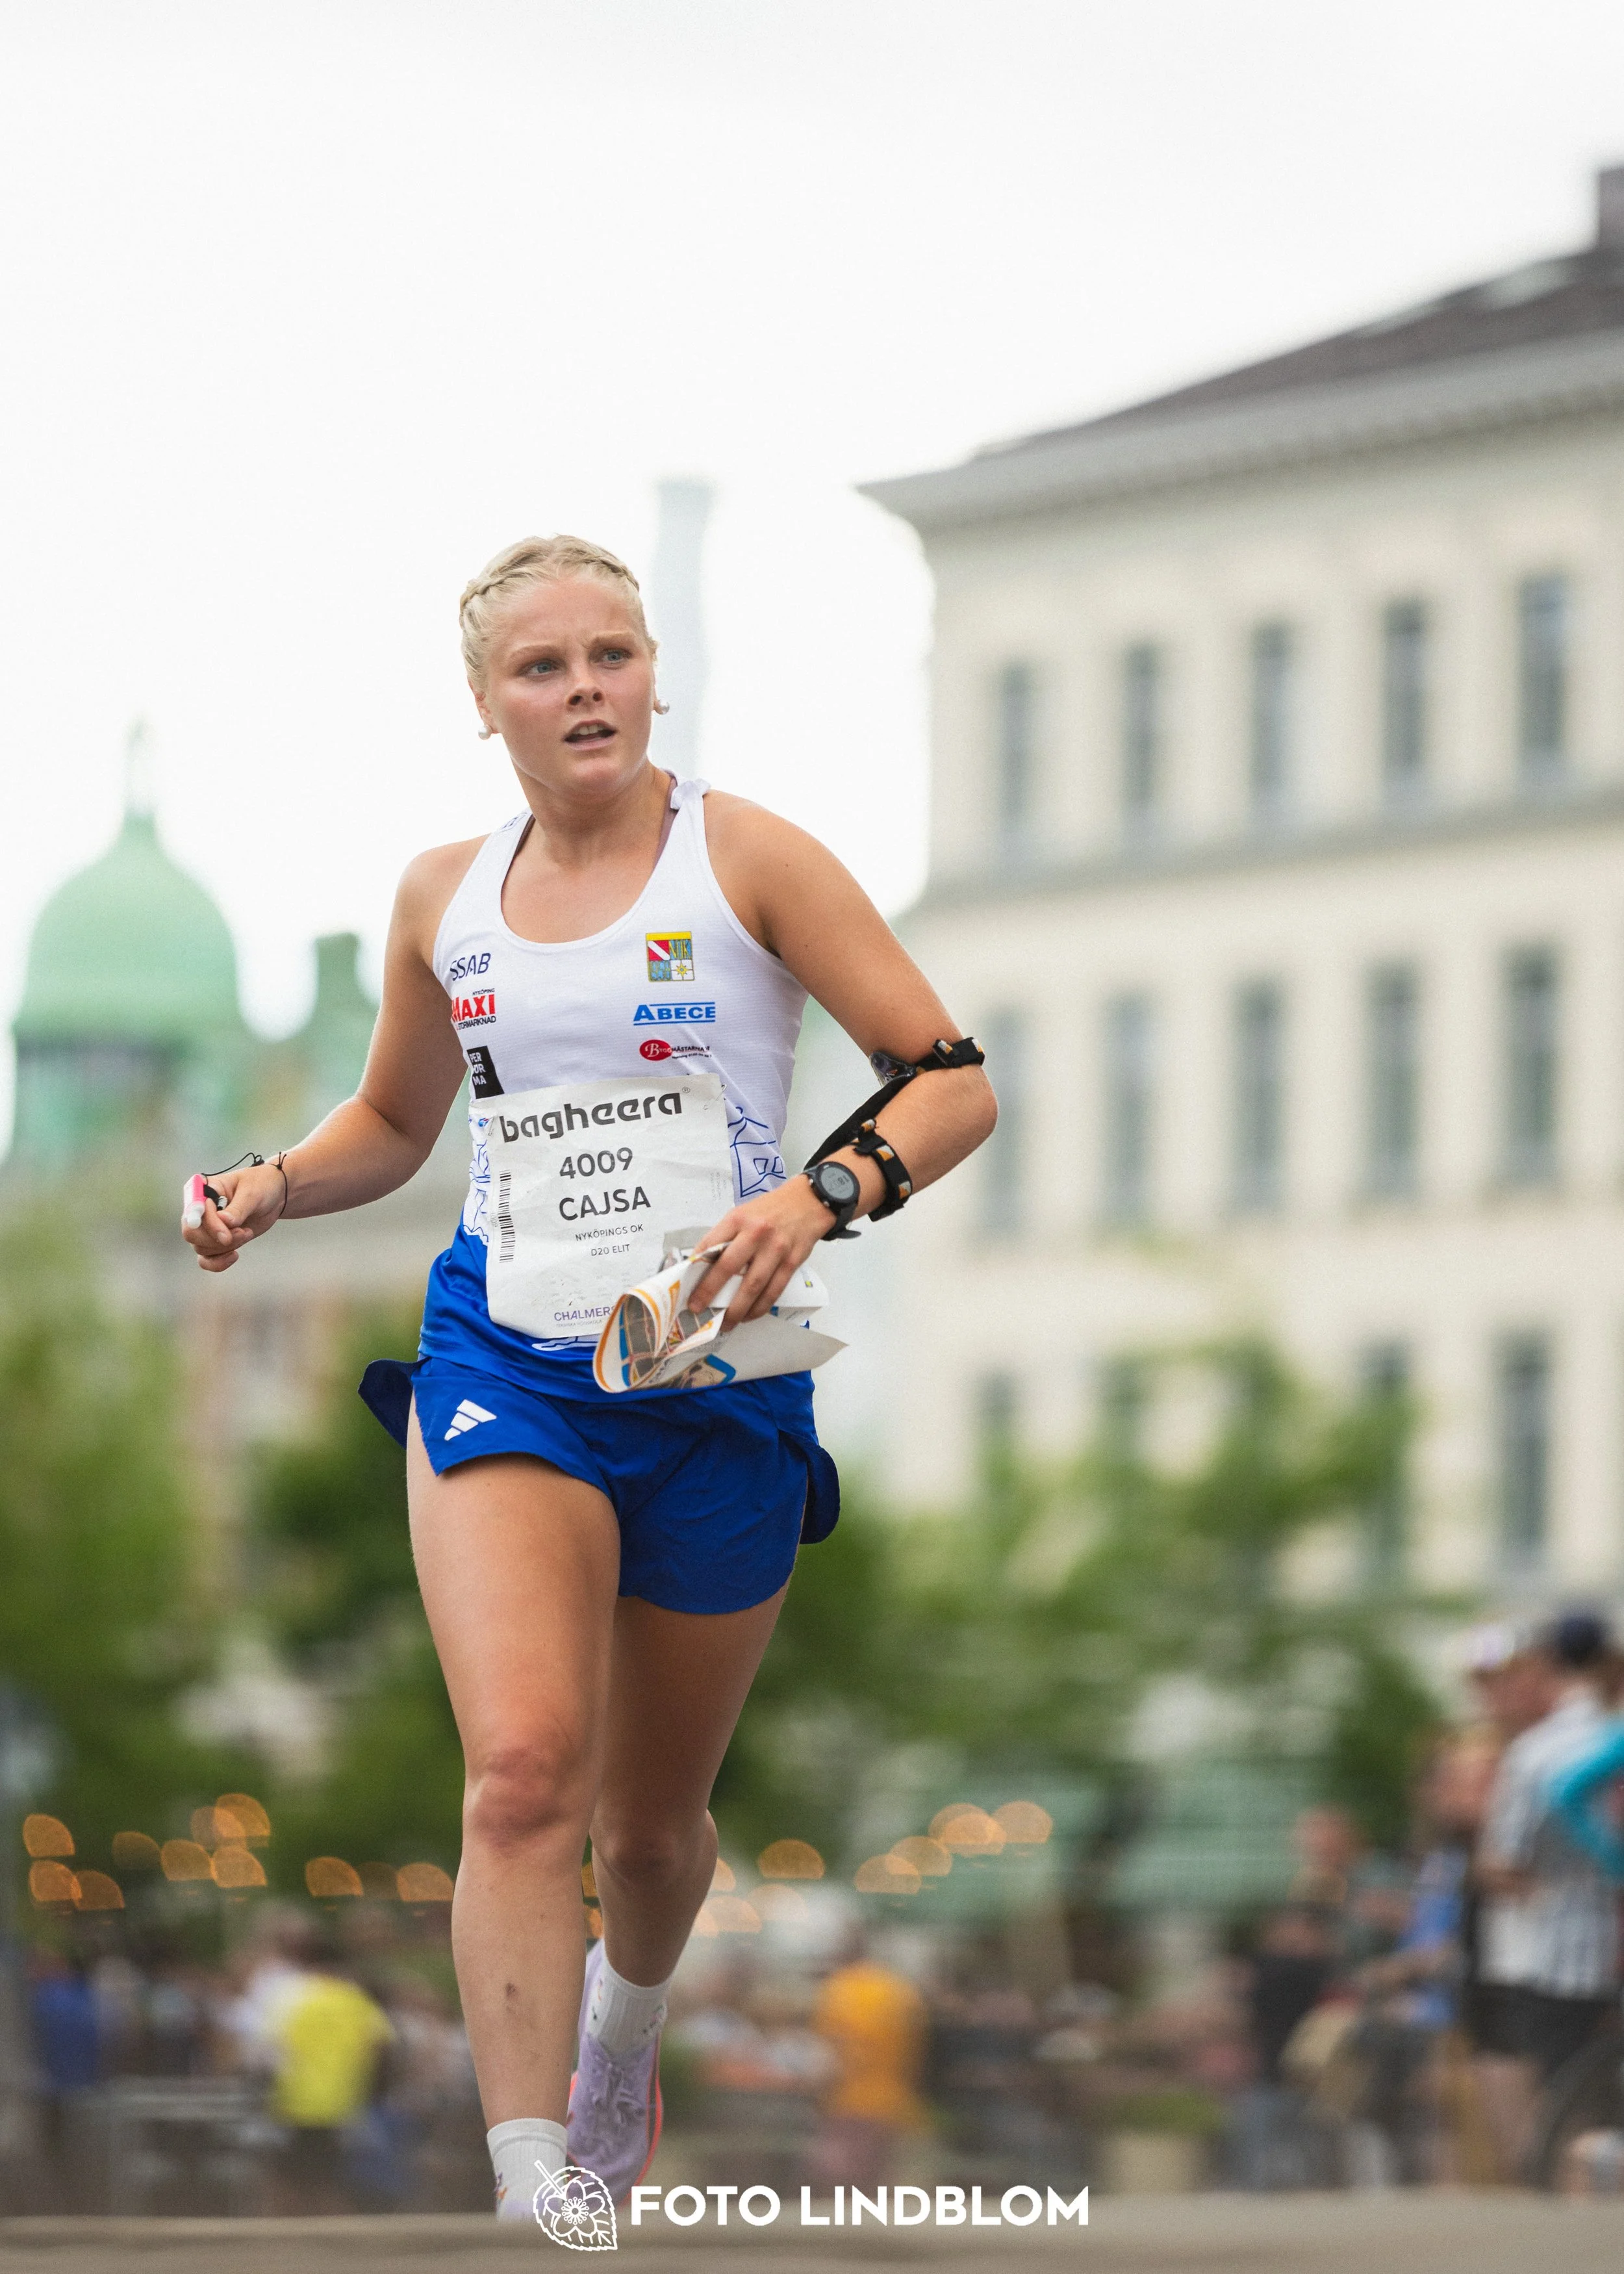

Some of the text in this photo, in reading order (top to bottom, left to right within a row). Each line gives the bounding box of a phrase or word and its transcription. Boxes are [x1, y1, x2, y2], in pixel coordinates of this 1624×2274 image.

[450, 952, 491, 982] SSAB
[451, 994, 496, 1023] MAXI
[633, 1004, 715, 1022] ABECE
[472, 1075, 487, 1086] MA
[499, 1092, 682, 1143] bagheera
[559, 1147, 633, 1179] 4009
[559, 1186, 652, 1221] CAJSA
[575, 1223, 644, 1242] NYKÖPINGS OK
[590, 1244, 630, 1257] D20 ELIT
